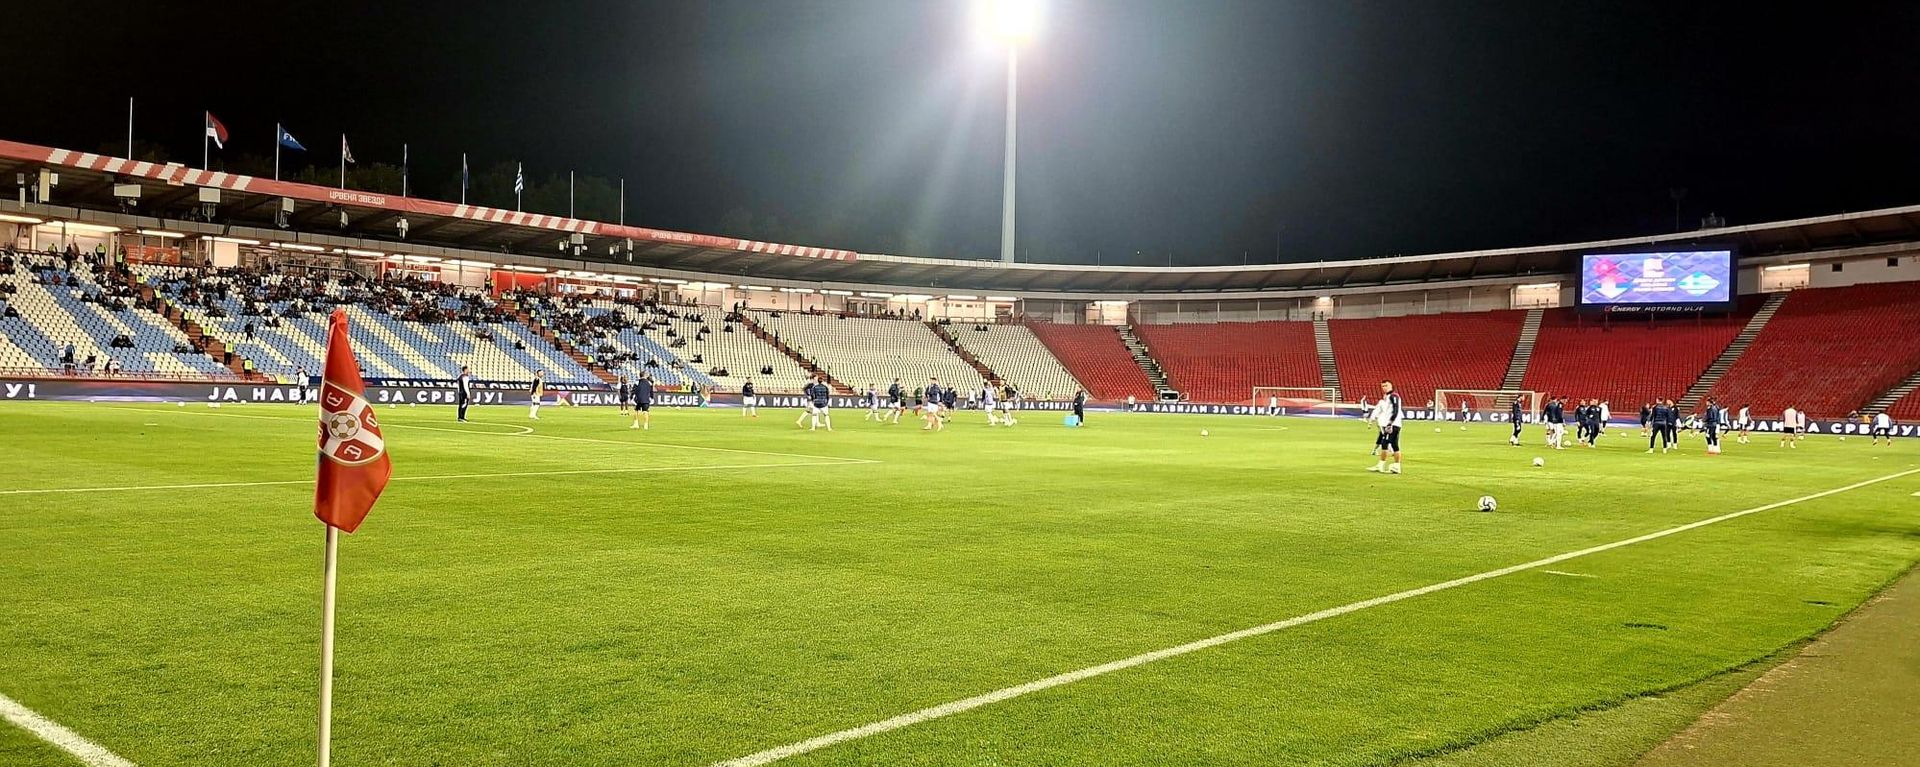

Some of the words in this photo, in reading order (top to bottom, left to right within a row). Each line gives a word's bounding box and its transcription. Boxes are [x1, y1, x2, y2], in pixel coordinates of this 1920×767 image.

[329, 190, 357, 202] ЦРВЕНА
[358, 194, 385, 205] ЗВЕЗДА
[208, 387, 238, 400] ЈА
[252, 387, 318, 401] НАВИ
[379, 390, 405, 402] ЗА
[416, 391, 503, 403] СРБЈУ!
[572, 393, 602, 405] UEFA
[657, 395, 699, 406] LEAGUE
[1153, 404, 1208, 413] НАВИЈАМ
[1213, 405, 1228, 414] ЗА
